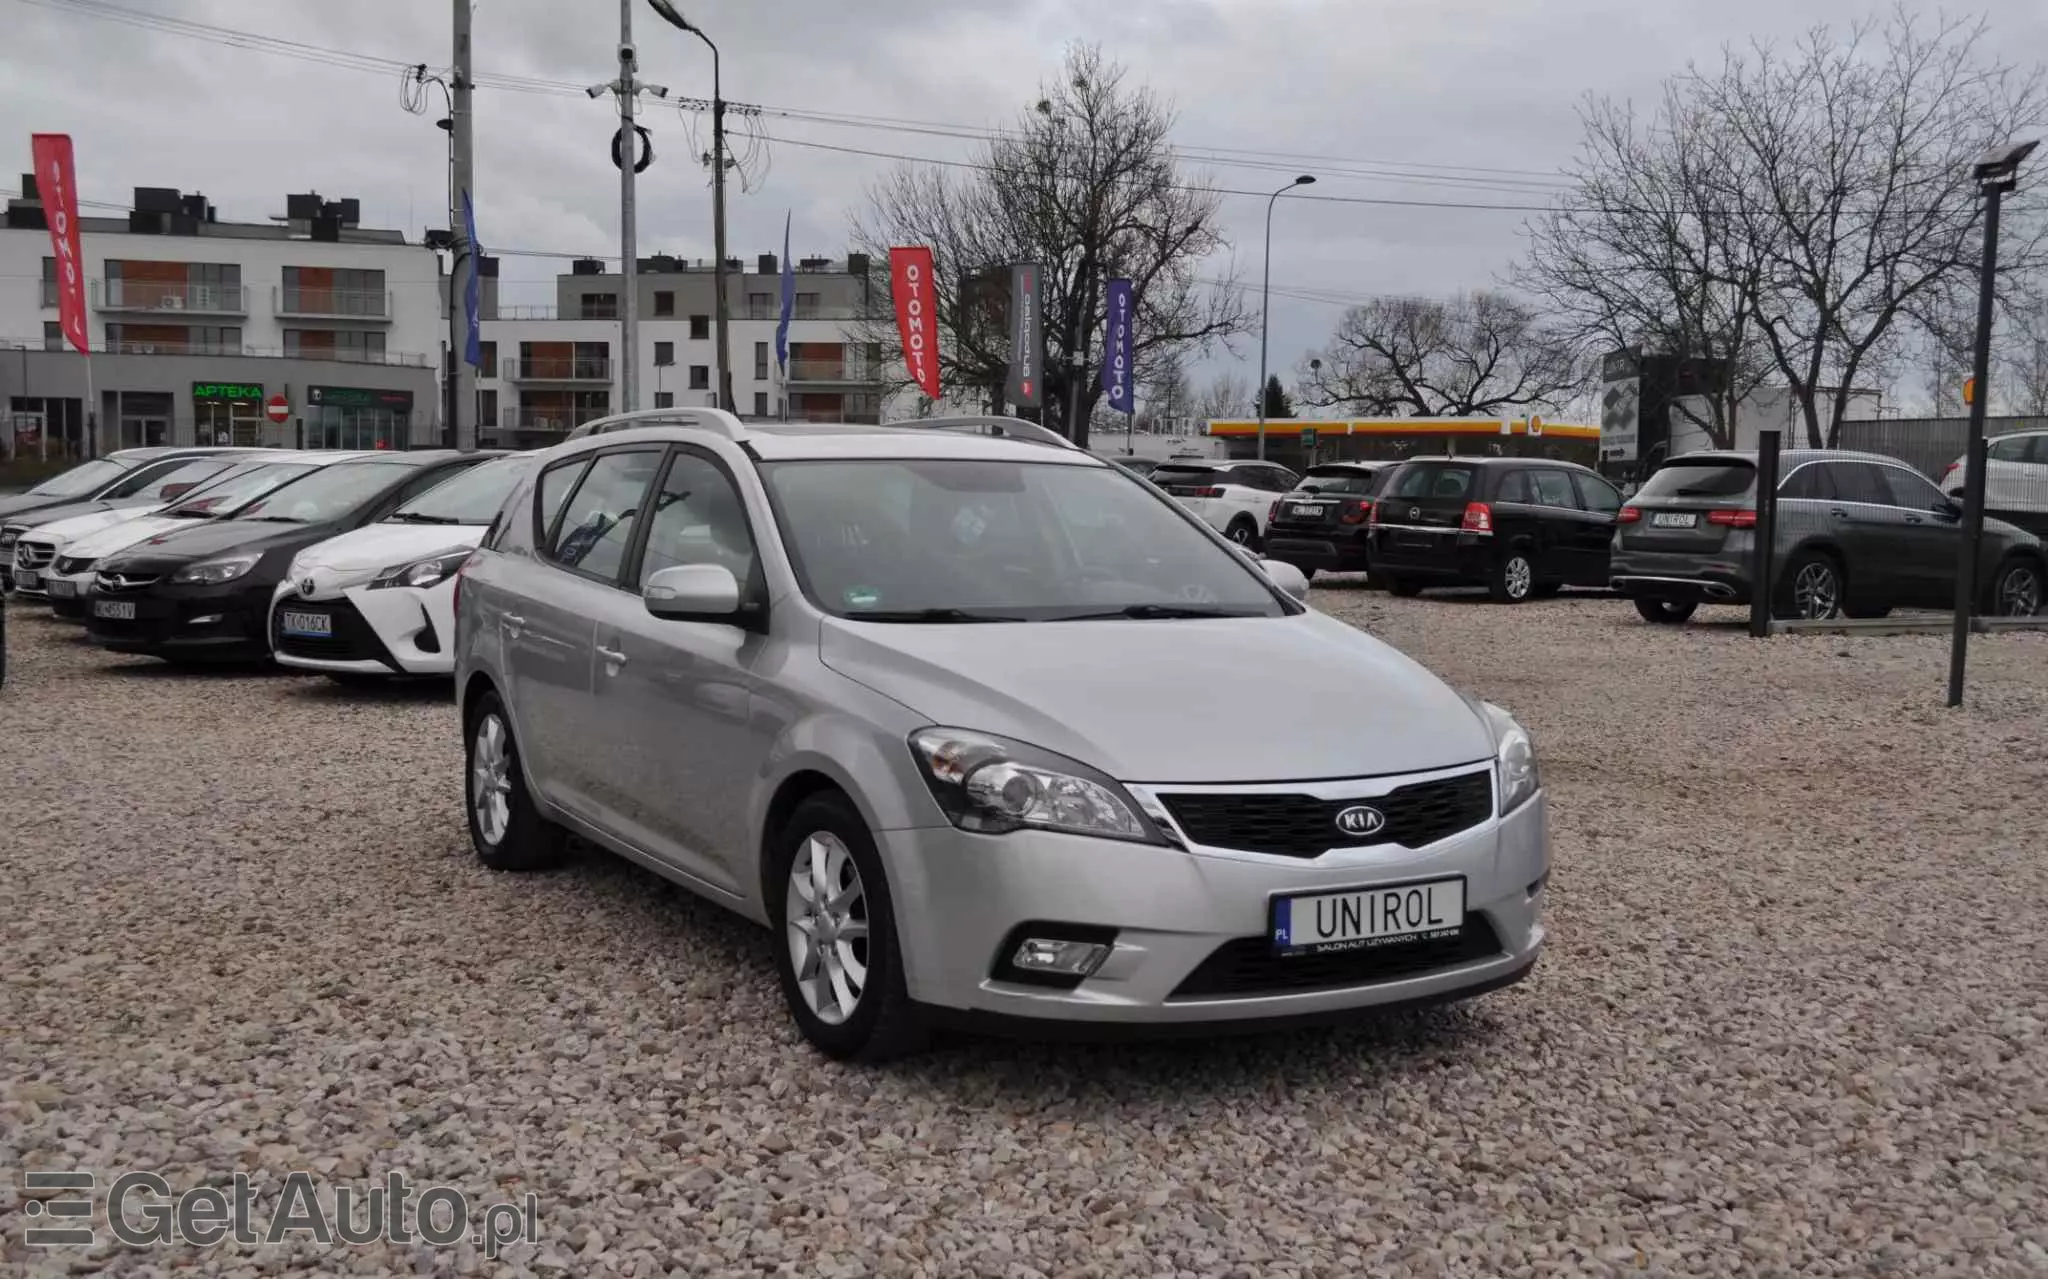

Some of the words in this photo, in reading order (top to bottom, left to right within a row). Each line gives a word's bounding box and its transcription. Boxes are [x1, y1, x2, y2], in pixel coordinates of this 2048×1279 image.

[906, 264, 925, 383] OTOMOTO
[1111, 293, 1126, 400] OTOMOTO
[194, 384, 262, 398] APTEKA
[1344, 812, 1379, 829] KIA
[1317, 887, 1443, 938] UNIROL
[1275, 928, 1289, 941] PL
